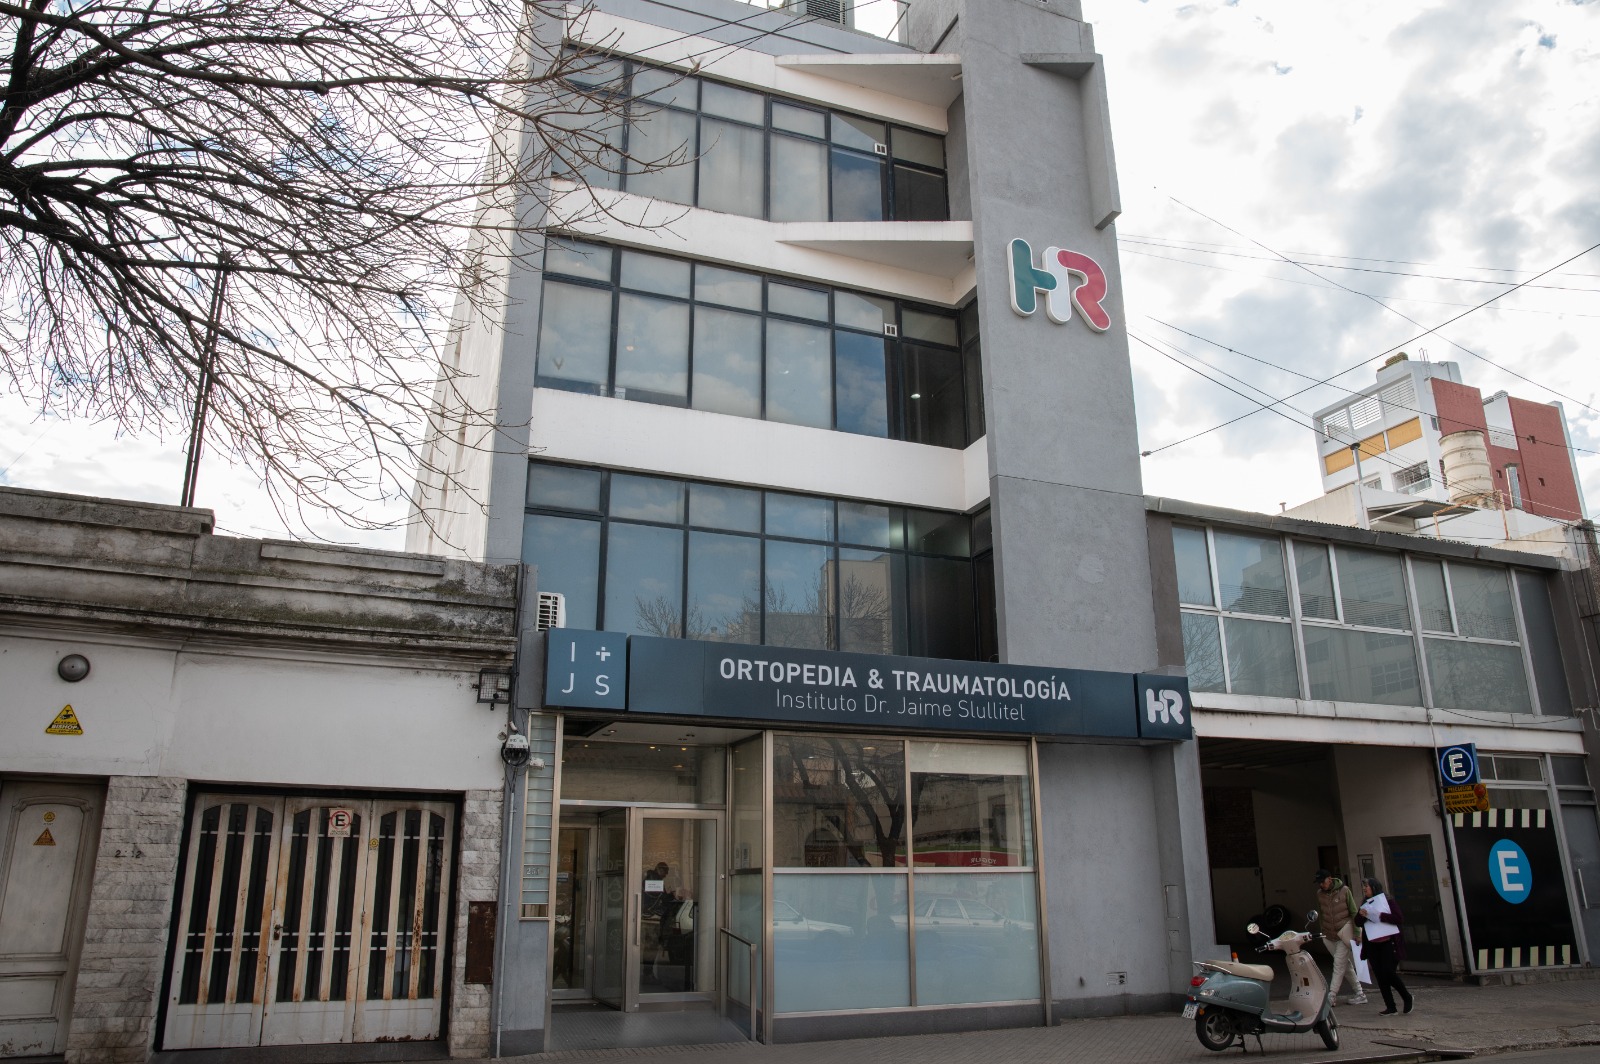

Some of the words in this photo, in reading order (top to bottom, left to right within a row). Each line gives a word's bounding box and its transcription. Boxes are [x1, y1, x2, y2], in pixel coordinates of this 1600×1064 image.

[1006, 237, 1111, 333] HR
[720, 658, 857, 688] ORTOPEDIA
[867, 668, 884, 690] &
[892, 670, 1072, 701] TRAUMATOLOGÍA
[776, 688, 857, 712] Instituto
[865, 694, 890, 714] Dr.
[897, 698, 952, 718] Jaime
[957, 699, 1025, 721] Slullitel
[1145, 688, 1185, 725] HR
[1448, 753, 1466, 778] E
[335, 814, 346, 827] E
[1496, 850, 1524, 892] E
